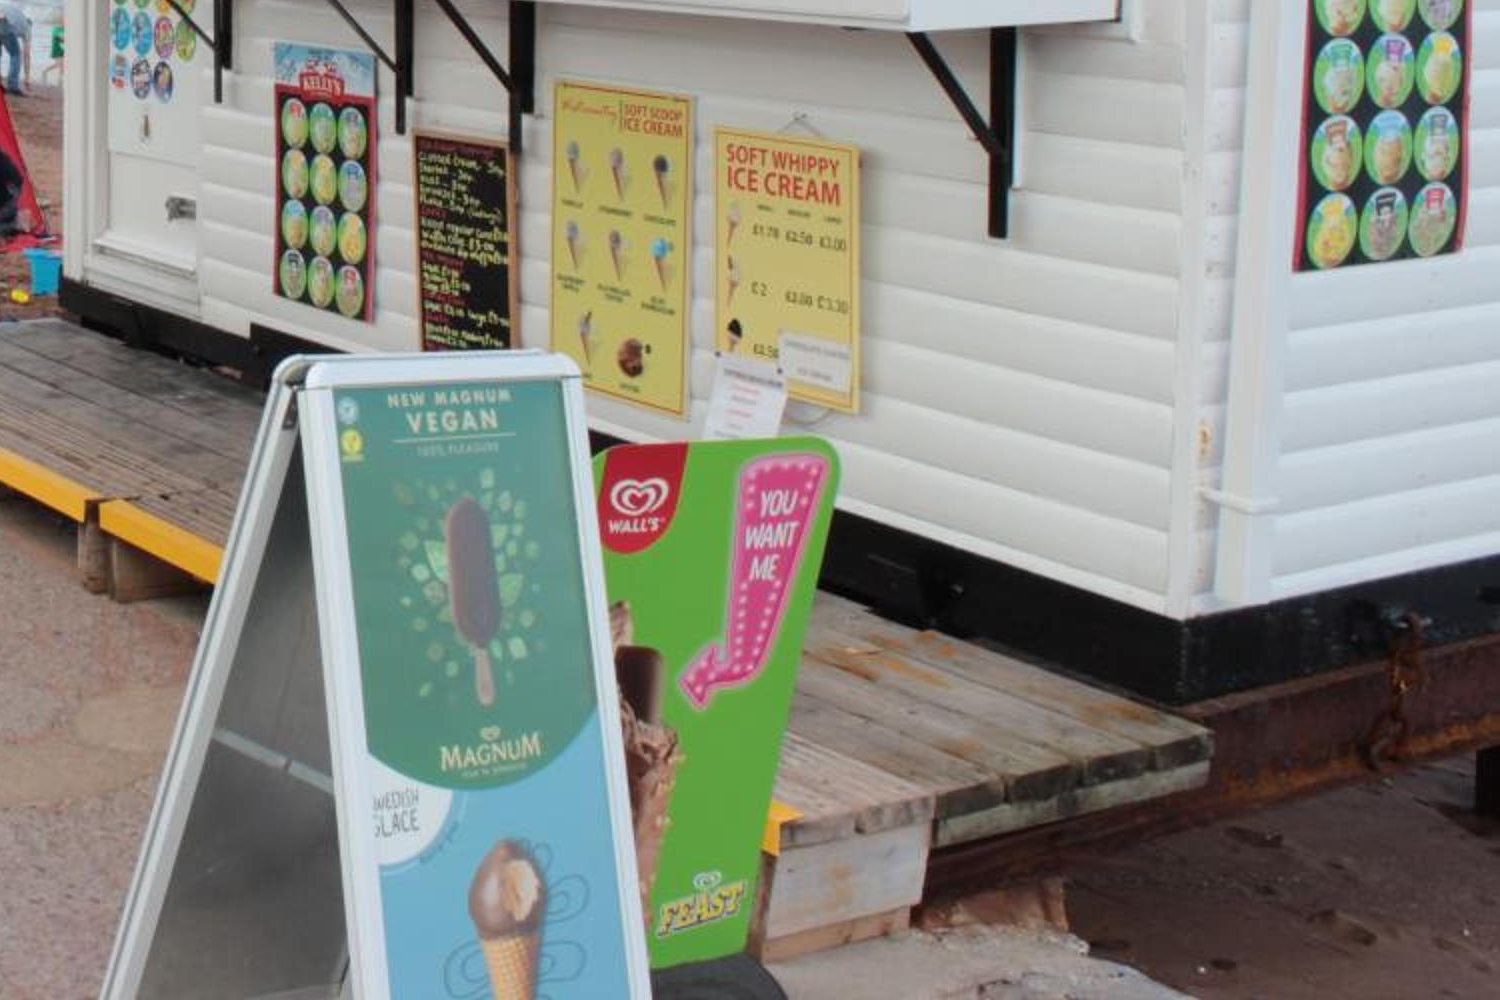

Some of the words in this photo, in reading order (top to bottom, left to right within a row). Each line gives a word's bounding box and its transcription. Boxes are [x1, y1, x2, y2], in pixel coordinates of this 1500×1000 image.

[624, 103, 648, 117] SOFT
[649, 106, 683, 121] SCOOP
[623, 118, 641, 132] ICE
[643, 120, 683, 137] CREAM
[726, 143, 768, 167] SOFT
[772, 151, 840, 178] WHIPPY
[727, 166, 758, 193] ICE
[764, 172, 841, 207] CREAM
[388, 391, 426, 408] NEW
[434, 387, 512, 407] MAGNUM
[405, 407, 498, 434] VEGAN
[760, 488, 799, 518] YOU
[608, 517, 660, 534] WALL'S
[745, 520, 800, 549] WANT
[750, 553, 780, 581] ME
[439, 731, 542, 772] MAGNUM
[372, 786, 420, 811] WEDISH
[657, 880, 746, 938] FEAST
